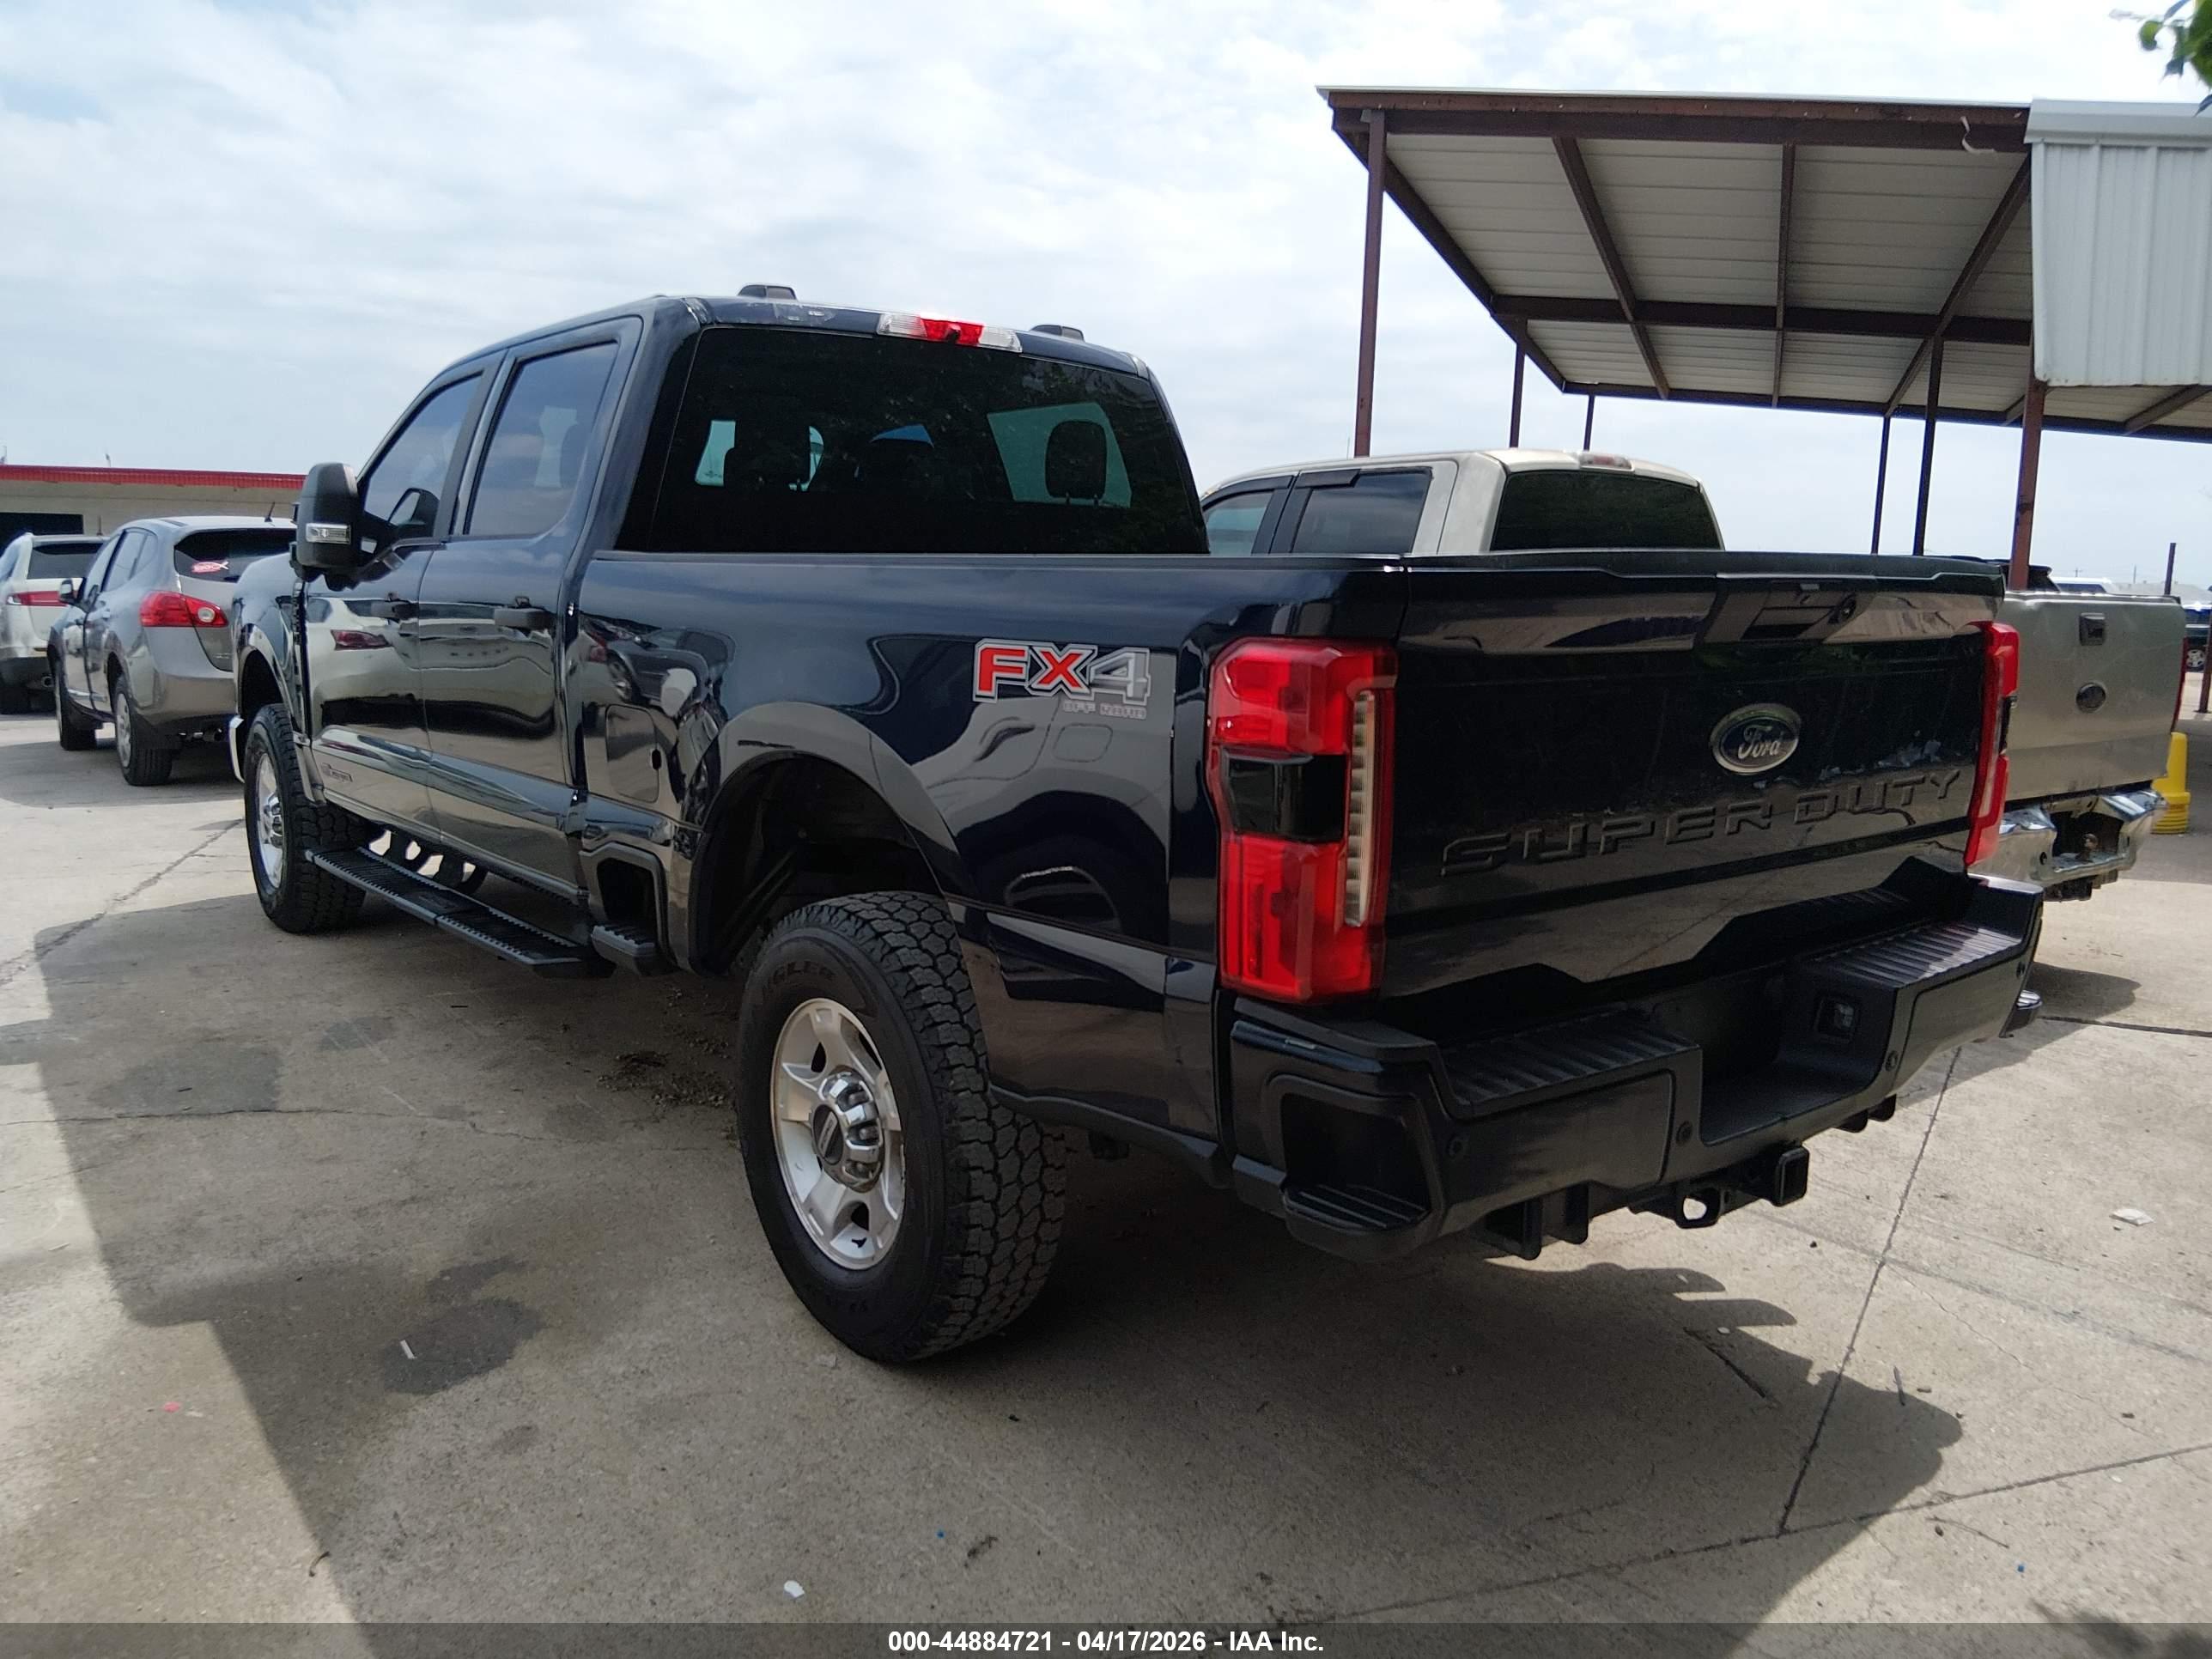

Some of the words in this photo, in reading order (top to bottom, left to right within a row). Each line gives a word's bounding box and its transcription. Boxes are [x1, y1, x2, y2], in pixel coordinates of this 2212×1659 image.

[973, 638, 1152, 705] FX4
[1737, 723, 1785, 760] Ford
[1440, 799, 1772, 877] SUPER
[1794, 769, 1960, 824] DUTY
